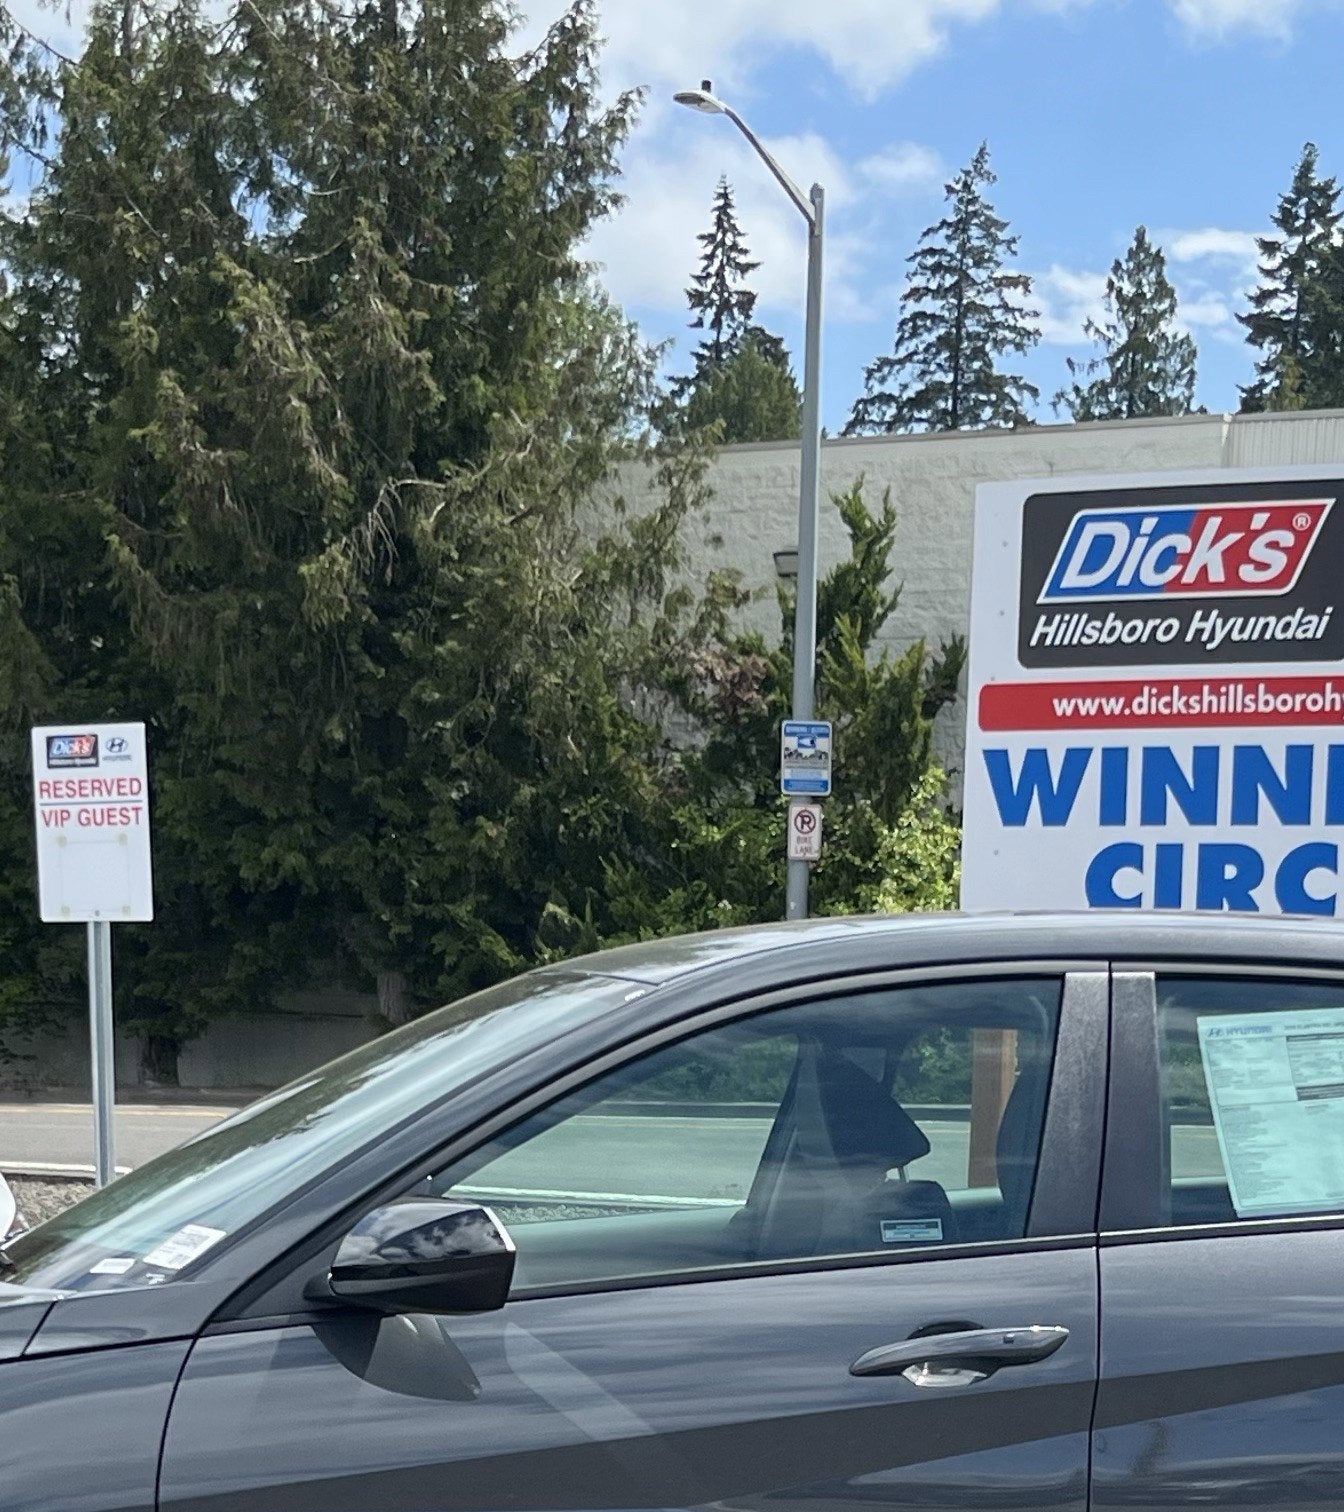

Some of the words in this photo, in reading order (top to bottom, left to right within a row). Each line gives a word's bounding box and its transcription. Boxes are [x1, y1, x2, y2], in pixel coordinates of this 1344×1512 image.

[1060, 512, 1295, 589] Dick's
[1029, 611, 1180, 648] Hillsboro
[1184, 606, 1335, 651] Hyundai
[39, 777, 142, 799] RESERVED
[42, 809, 71, 828] VIP
[78, 807, 143, 827] GUEST
